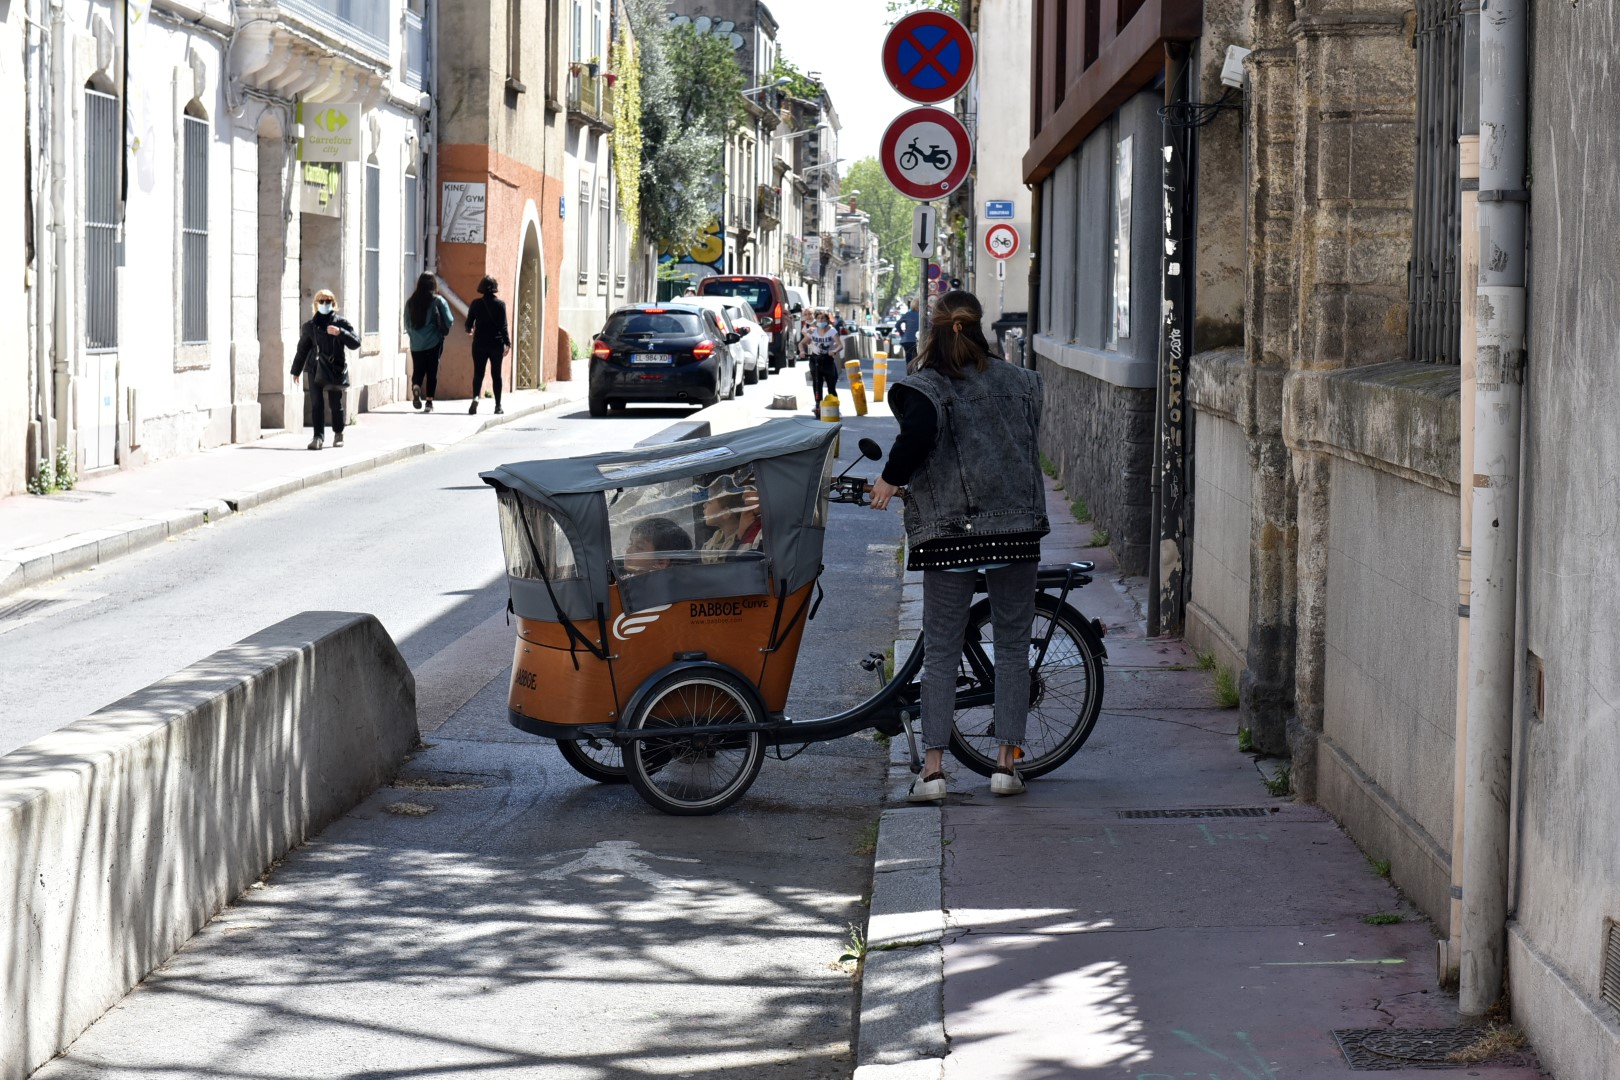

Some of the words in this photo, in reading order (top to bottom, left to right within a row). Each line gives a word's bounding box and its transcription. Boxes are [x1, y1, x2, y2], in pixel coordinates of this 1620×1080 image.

[309, 135, 352, 145] Carrefour
[322, 145, 339, 156] city
[444, 184, 465, 192] KINE
[465, 195, 485, 203] GYM
[690, 602, 742, 617] BABBOE
